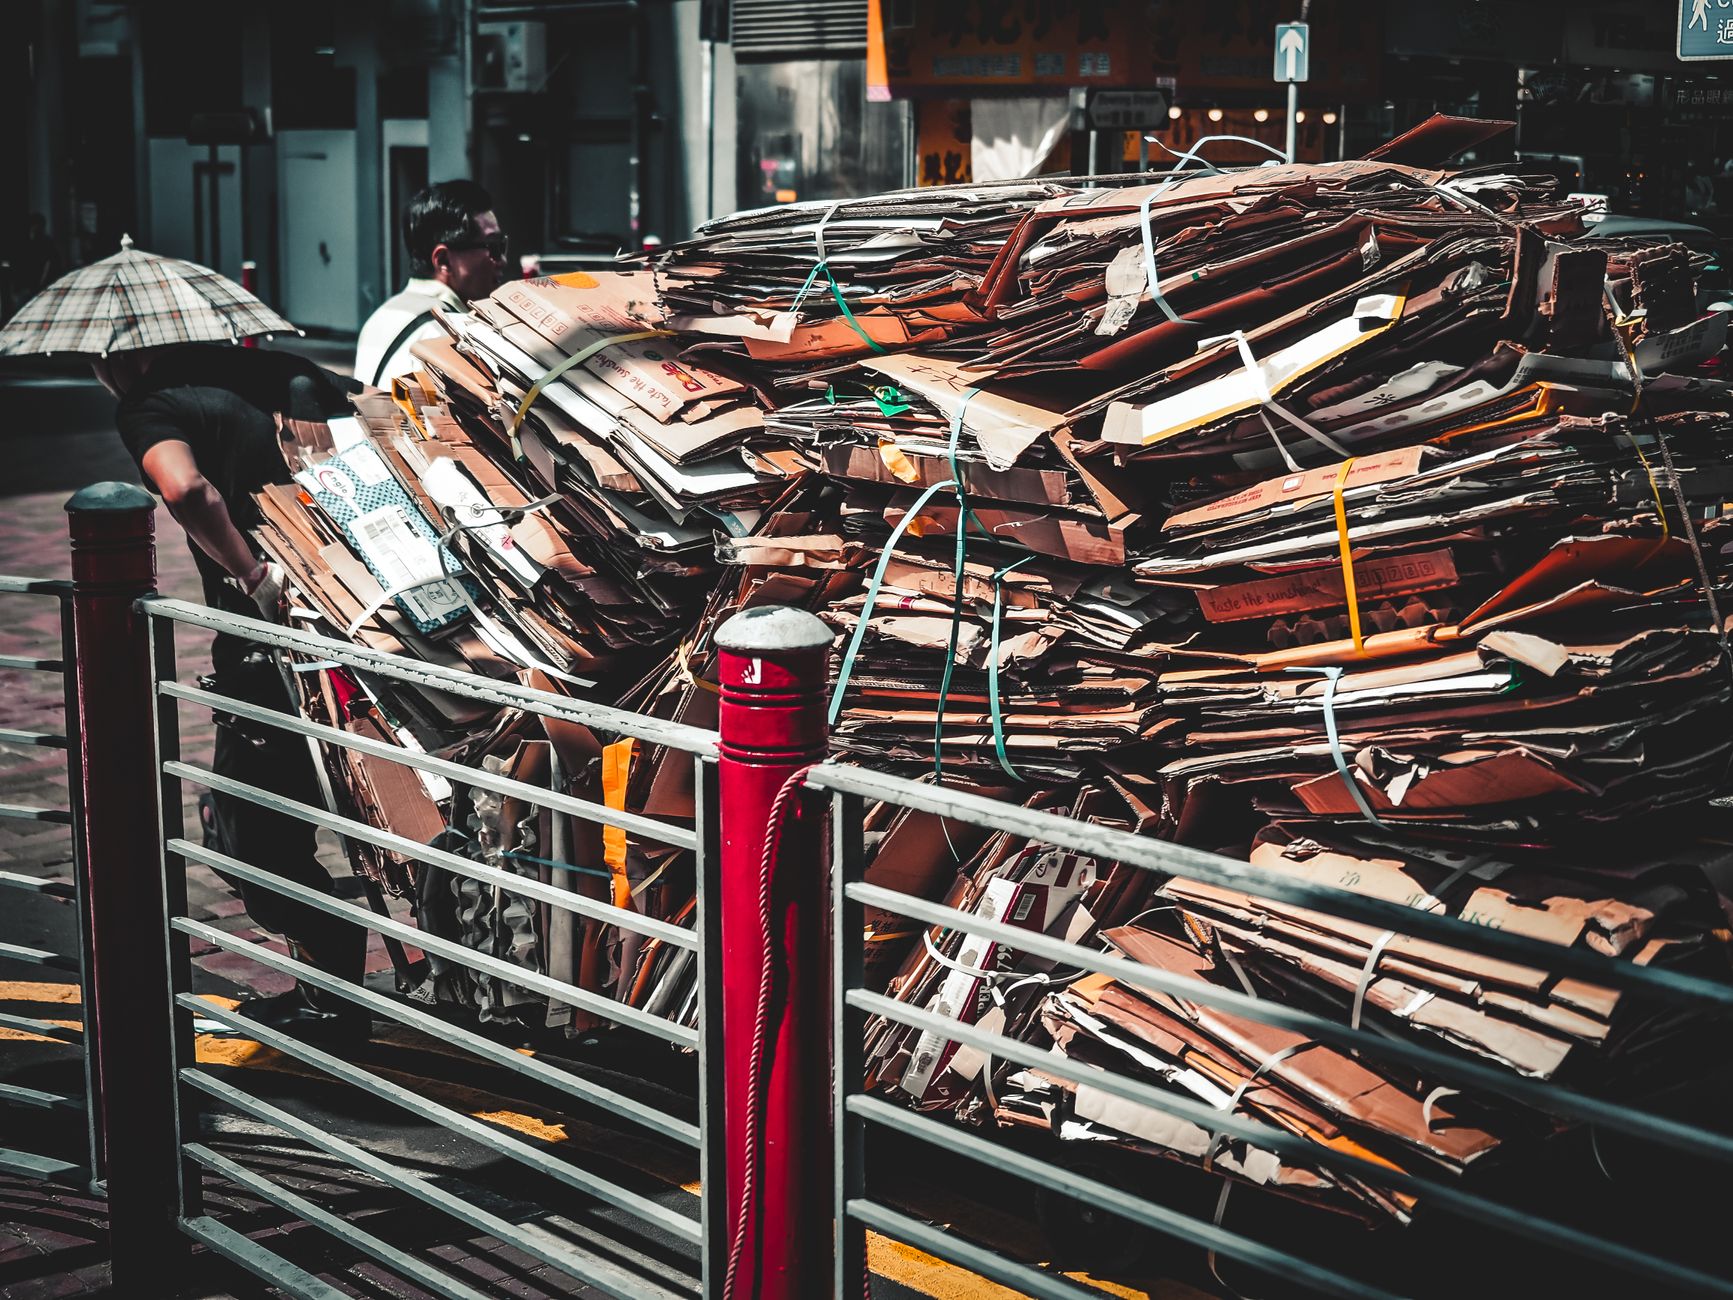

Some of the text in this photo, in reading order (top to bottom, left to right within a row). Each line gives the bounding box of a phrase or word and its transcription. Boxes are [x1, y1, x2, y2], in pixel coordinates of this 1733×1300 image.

[633, 375, 646, 393] the
[661, 363, 703, 393] Dole
[645, 386, 671, 408] Taste
[1209, 597, 1240, 613] Taste
[1242, 592, 1263, 606] the
